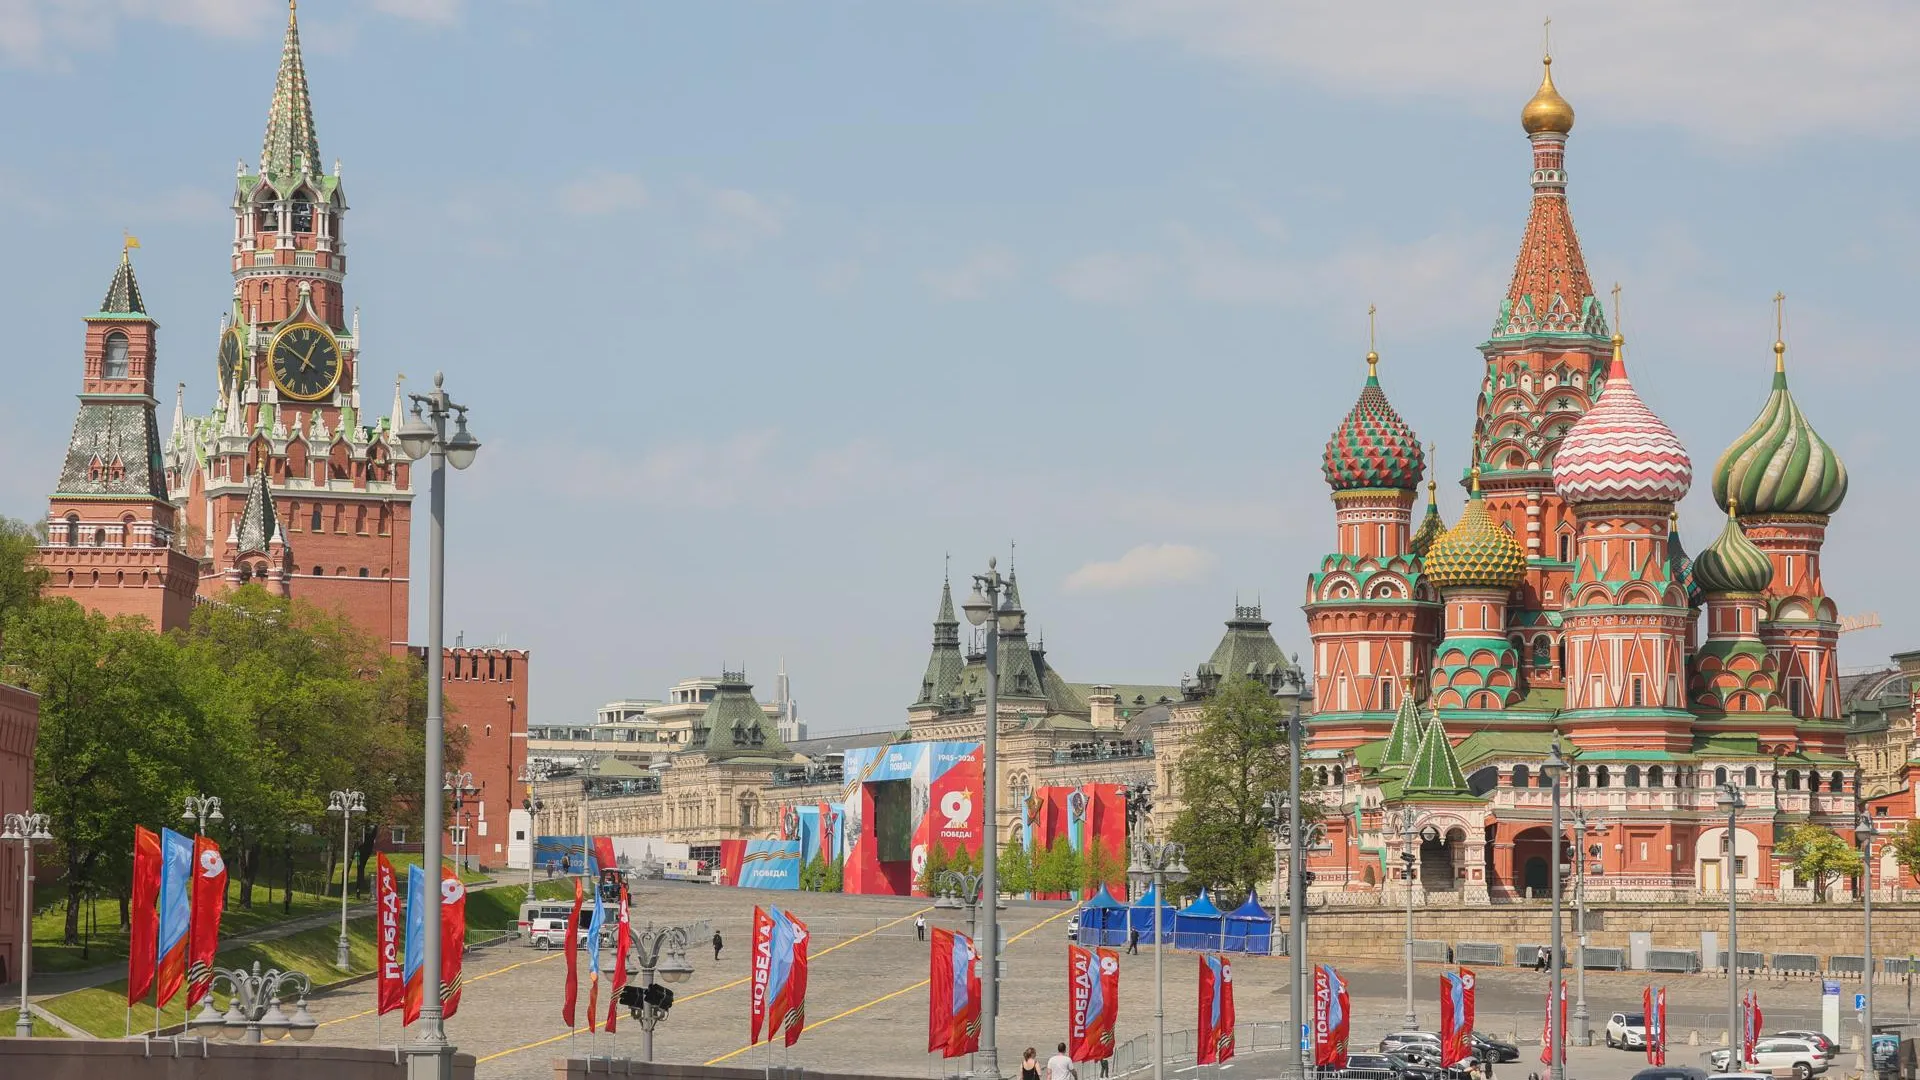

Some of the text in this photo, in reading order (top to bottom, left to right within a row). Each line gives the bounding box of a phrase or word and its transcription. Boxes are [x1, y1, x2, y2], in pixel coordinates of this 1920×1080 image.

[941, 831, 972, 839] ПОБЕДА!
[753, 869, 788, 878] ПОБЕДА!
[1074, 953, 1091, 1038] ПОБЕДА!
[1317, 971, 1330, 1044] ПОБЕДА!
